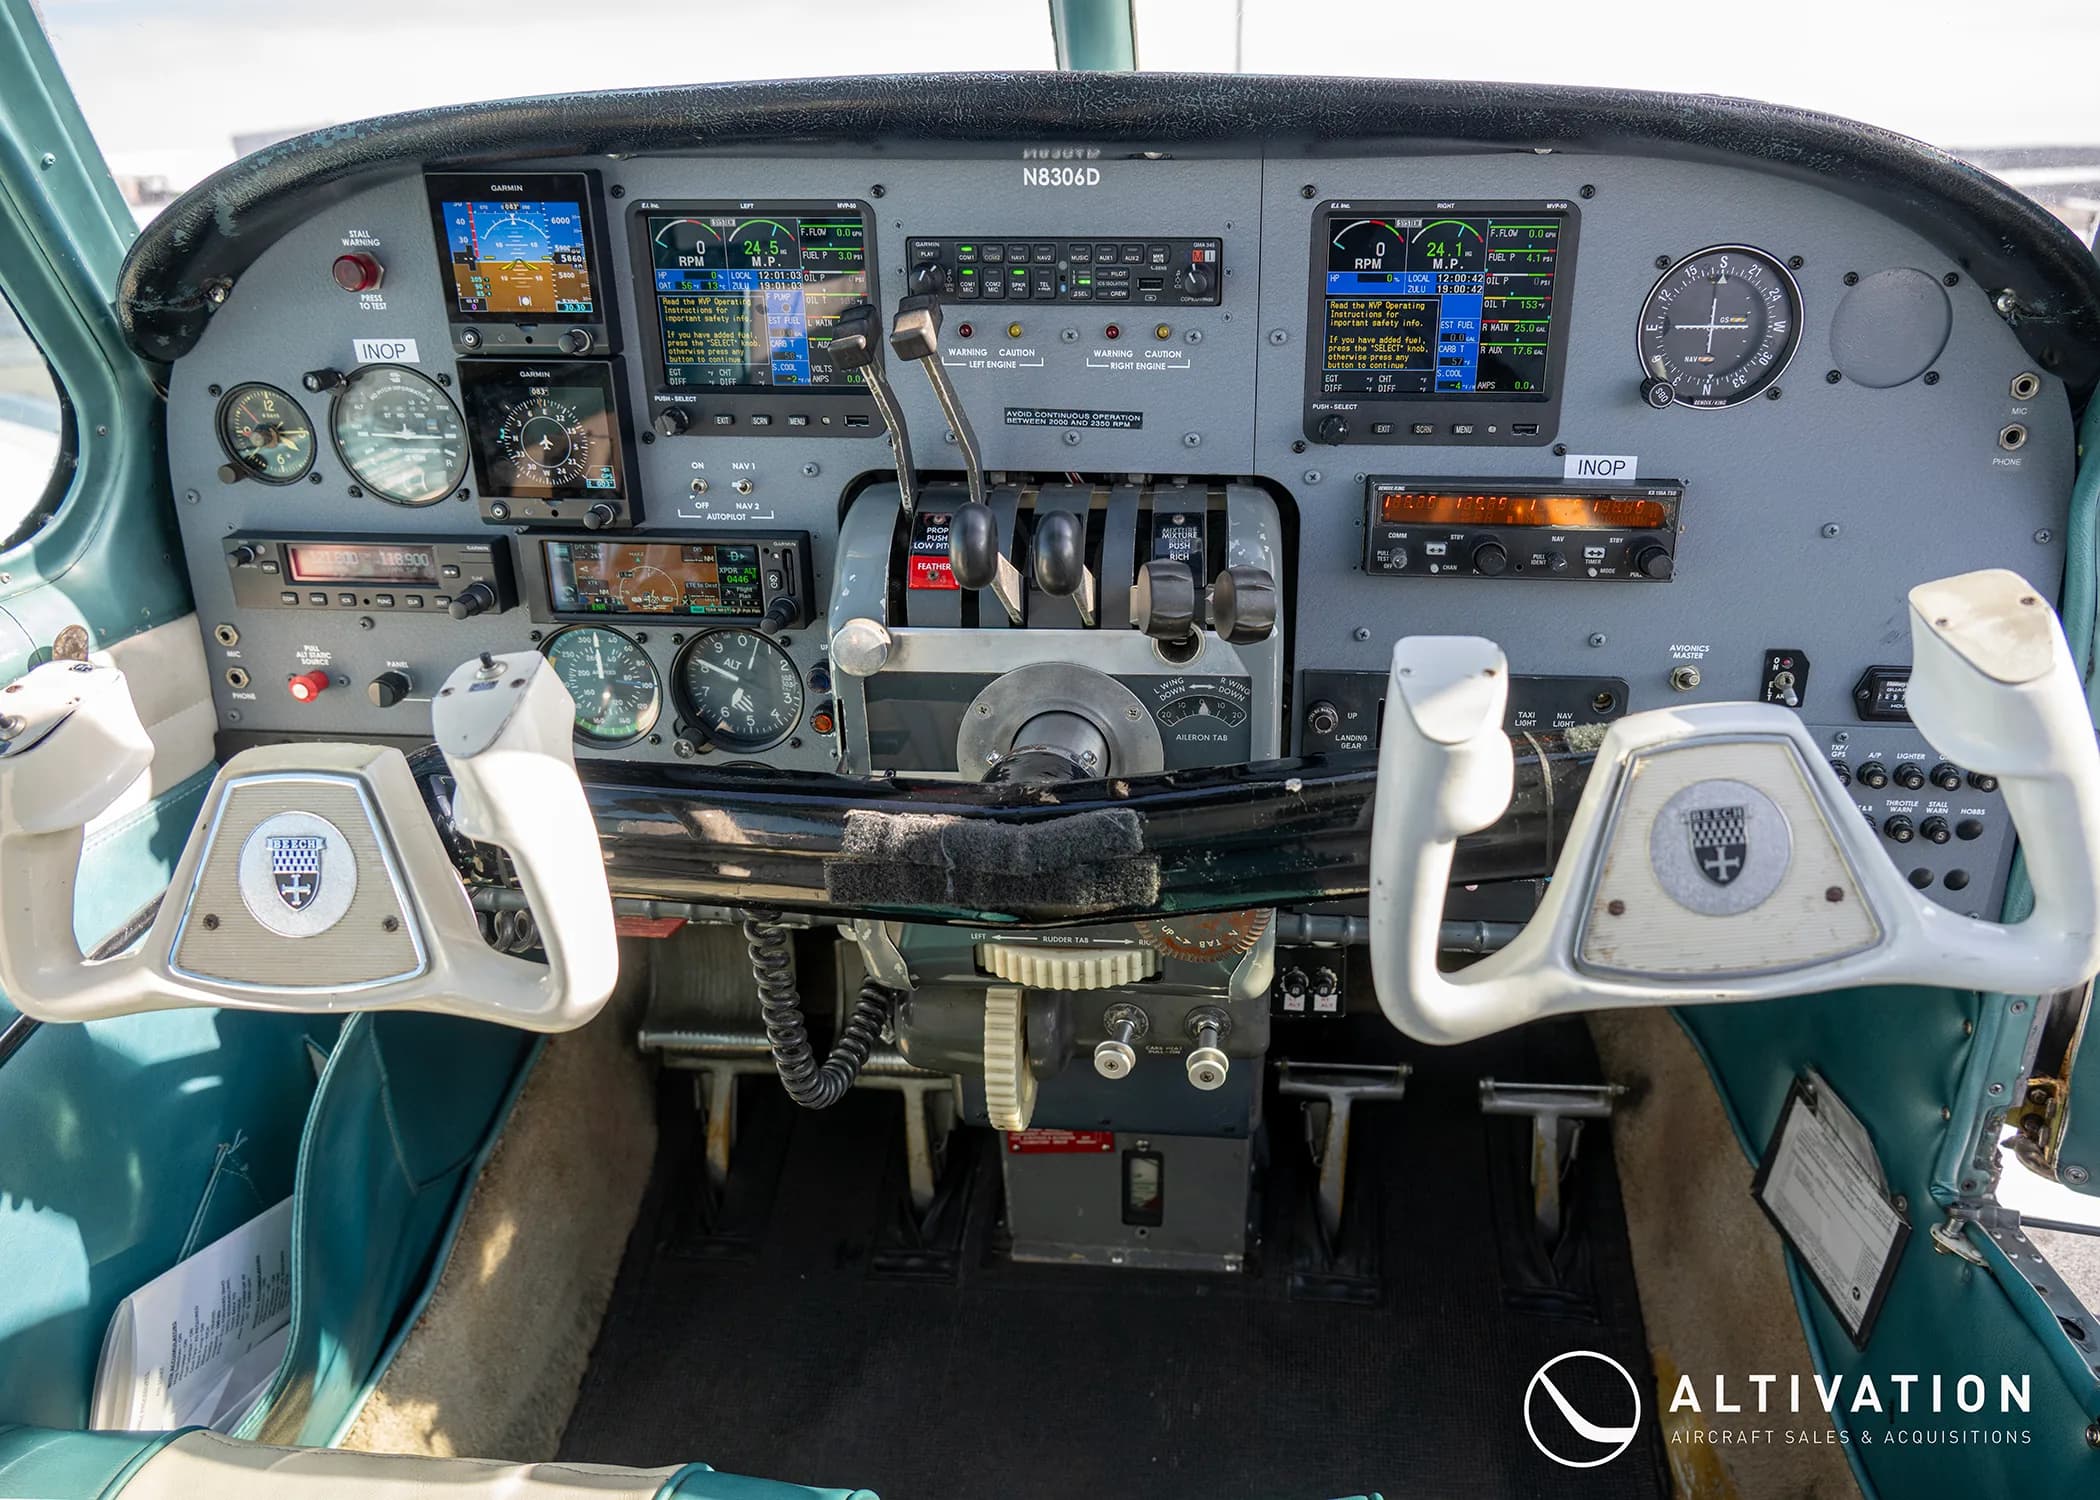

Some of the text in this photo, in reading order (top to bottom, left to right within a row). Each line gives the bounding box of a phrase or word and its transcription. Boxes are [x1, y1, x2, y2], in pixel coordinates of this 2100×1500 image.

[1023, 168, 1100, 186] N8306D
[490, 184, 523, 192] GARMIN
[348, 230, 370, 238] STALL
[1490, 228, 1544, 238] F.FLOW 0.0
[341, 238, 381, 247] WARNING
[743, 241, 779, 255] 24.5
[1427, 242, 1462, 257] 24.1
[679, 255, 704, 267] RPM
[752, 256, 782, 267] M.P.
[1354, 258, 1382, 270] RPM
[1432, 259, 1464, 270] M.P.
[1684, 264, 1697, 278] 15
[1748, 264, 1762, 277] 21
[1408, 274, 1484, 283] LOCAL 12:00:42
[1407, 285, 1483, 294] ZULU 19:00:42
[361, 294, 383, 302] PRESS
[1658, 289, 1672, 302] 12
[1768, 288, 1782, 301] 24
[359, 302, 387, 310] TO TEST
[1330, 301, 1425, 311] Read the MVP Operating
[1330, 310, 1399, 318] Instructions for
[1330, 319, 1424, 328] important safety info.
[1329, 336, 1339, 344] If
[1341, 337, 1356, 345] you
[1358, 336, 1377, 344] have
[1379, 336, 1403, 344] added
[362, 343, 406, 360] INOP
[948, 349, 988, 357] WARNING
[999, 349, 1035, 357] CAUTION
[1093, 350, 1133, 358] WARNING
[1144, 350, 1182, 358] CAUTION
[1327, 353, 1410, 363] otherwise press any
[1758, 352, 1773, 366] 30
[969, 360, 1017, 369] LEFT ENGINE
[1110, 362, 1166, 370] RIGHT ENGINE
[1477, 381, 1530, 390] AMPS 0.0
[1654, 387, 1668, 402] OBS
[263, 400, 275, 412] 12
[1006, 410, 1141, 422] AVOID CONTINUOUS OPERATION
[1048, 418, 1067, 426] 2000
[1377, 425, 1391, 433] EXIT
[1415, 425, 1433, 434] SCRN
[1455, 425, 1473, 434] MENU
[691, 462, 704, 470] ON
[732, 462, 756, 470] NAV 1
[1578, 459, 1626, 476] INOP
[736, 502, 760, 510] NAV 2
[707, 513, 746, 521] AUTOPILOT
[1168, 542, 1191, 550] PUSH
[1169, 553, 1189, 561] RICH
[727, 575, 749, 584] 0446
[1669, 644, 1710, 653] AVIONICS
[309, 652, 332, 660] STATIC
[1672, 651, 1704, 659] MASTER
[301, 658, 329, 666] SOURCE
[723, 659, 742, 670] ALT
[232, 692, 256, 700] PHONE
[1159, 687, 1186, 701] DOWN
[1218, 686, 1246, 702] DOWN
[1177, 701, 1186, 709] 10
[1217, 702, 1226, 710] 10
[1161, 711, 1172, 719] 20
[1232, 711, 1242, 719] 20
[1557, 712, 1573, 720] NAV
[1553, 720, 1575, 728] LIGHT
[1175, 733, 1228, 742] AILERON TAB
[1335, 734, 1368, 742] LANDING
[1341, 742, 1362, 750] GEAR
[1690, 807, 1744, 821] BEECH
[272, 838, 317, 850] BEECH
[1042, 935, 1089, 944] RUDDER TAB
